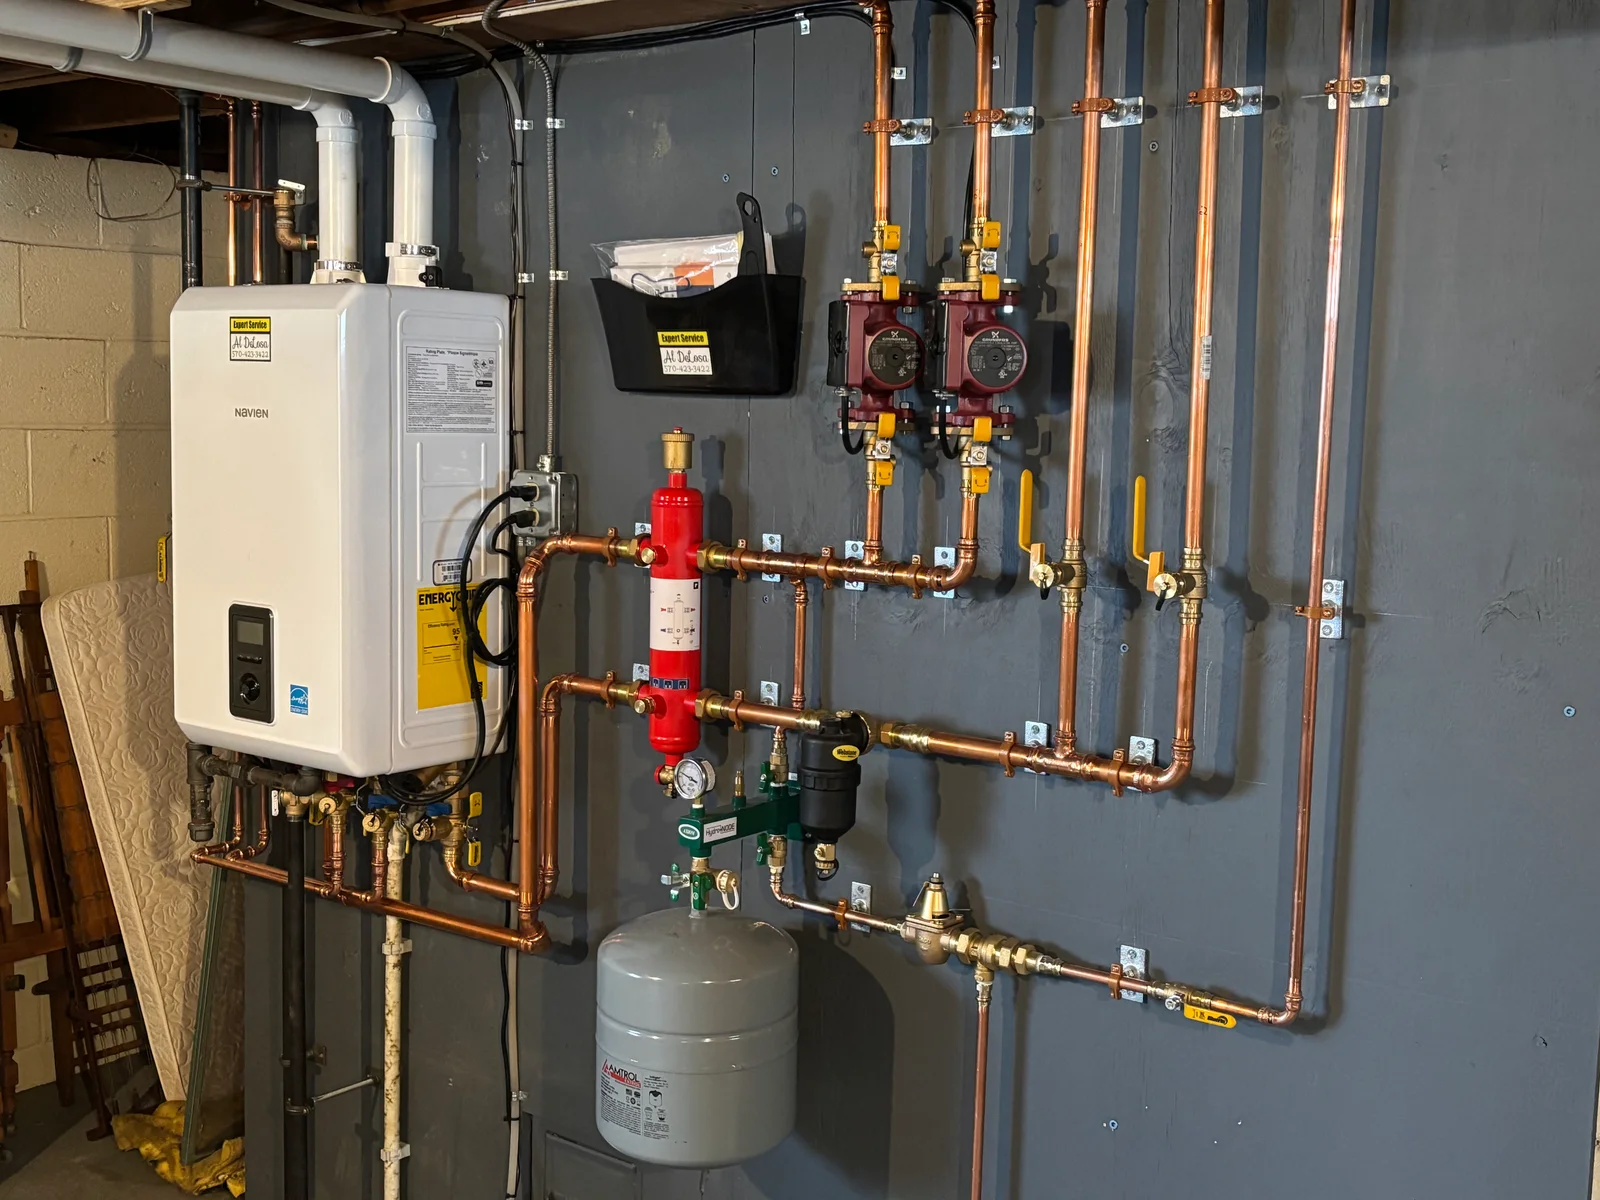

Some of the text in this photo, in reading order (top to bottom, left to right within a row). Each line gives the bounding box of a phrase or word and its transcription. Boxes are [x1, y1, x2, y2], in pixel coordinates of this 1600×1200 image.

[233, 320, 267, 329] Expert Service
[661, 333, 704, 343] Expert Service
[452, 627, 460, 635] 95
[608, 1064, 640, 1082] AMTROL
